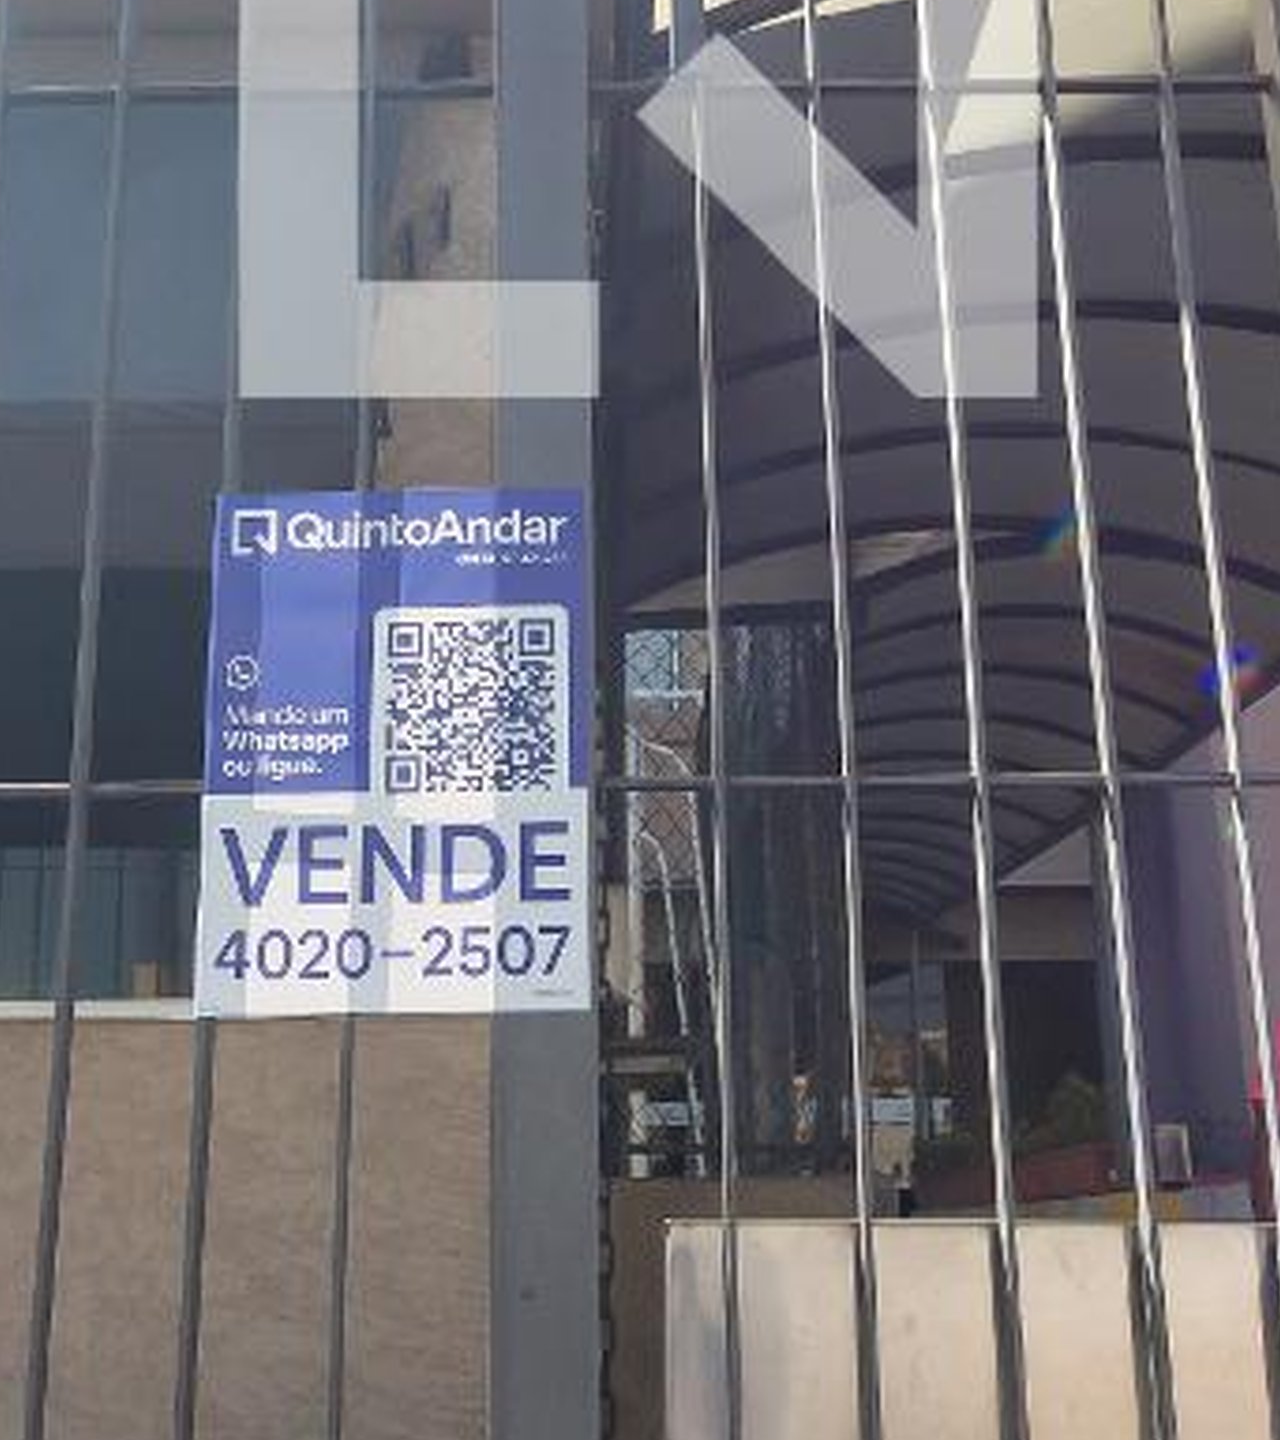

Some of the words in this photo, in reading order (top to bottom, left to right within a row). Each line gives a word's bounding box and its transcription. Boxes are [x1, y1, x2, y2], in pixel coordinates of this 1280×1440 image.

[286, 509, 568, 552] QuintoAndar
[221, 821, 573, 906] VENDE
[214, 926, 572, 981] 4020-2507
